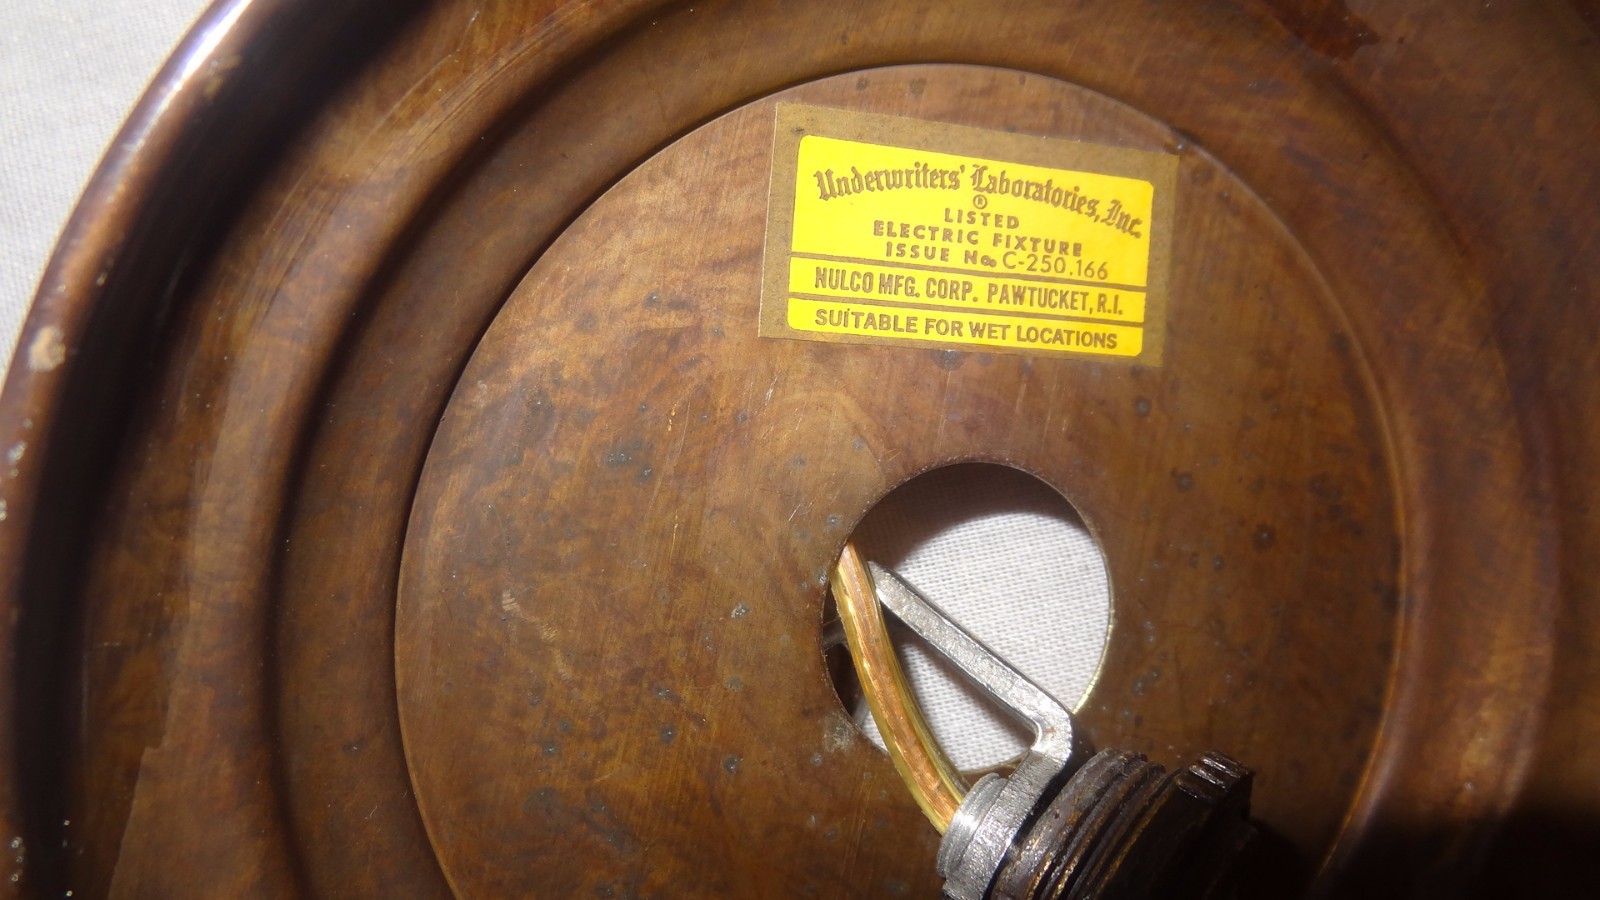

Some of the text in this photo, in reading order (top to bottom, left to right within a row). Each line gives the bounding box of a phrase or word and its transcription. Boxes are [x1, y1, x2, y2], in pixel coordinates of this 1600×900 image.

[813, 162, 965, 201] Underwriters'
[1100, 199, 1143, 239] Inc.
[945, 207, 1019, 229] LISTED
[873, 220, 1082, 257] ELECTRIC FIXTURE
[886, 241, 949, 262] ISSUE
[1002, 251, 1108, 280] C-250.166
[815, 266, 1123, 316] NULCO MFG. CORP. PAWTUCKET, R.I.
[924, 318, 963, 337] FOR
[969, 321, 1011, 340] WET
[1016, 325, 1117, 349] LOCATIONS
